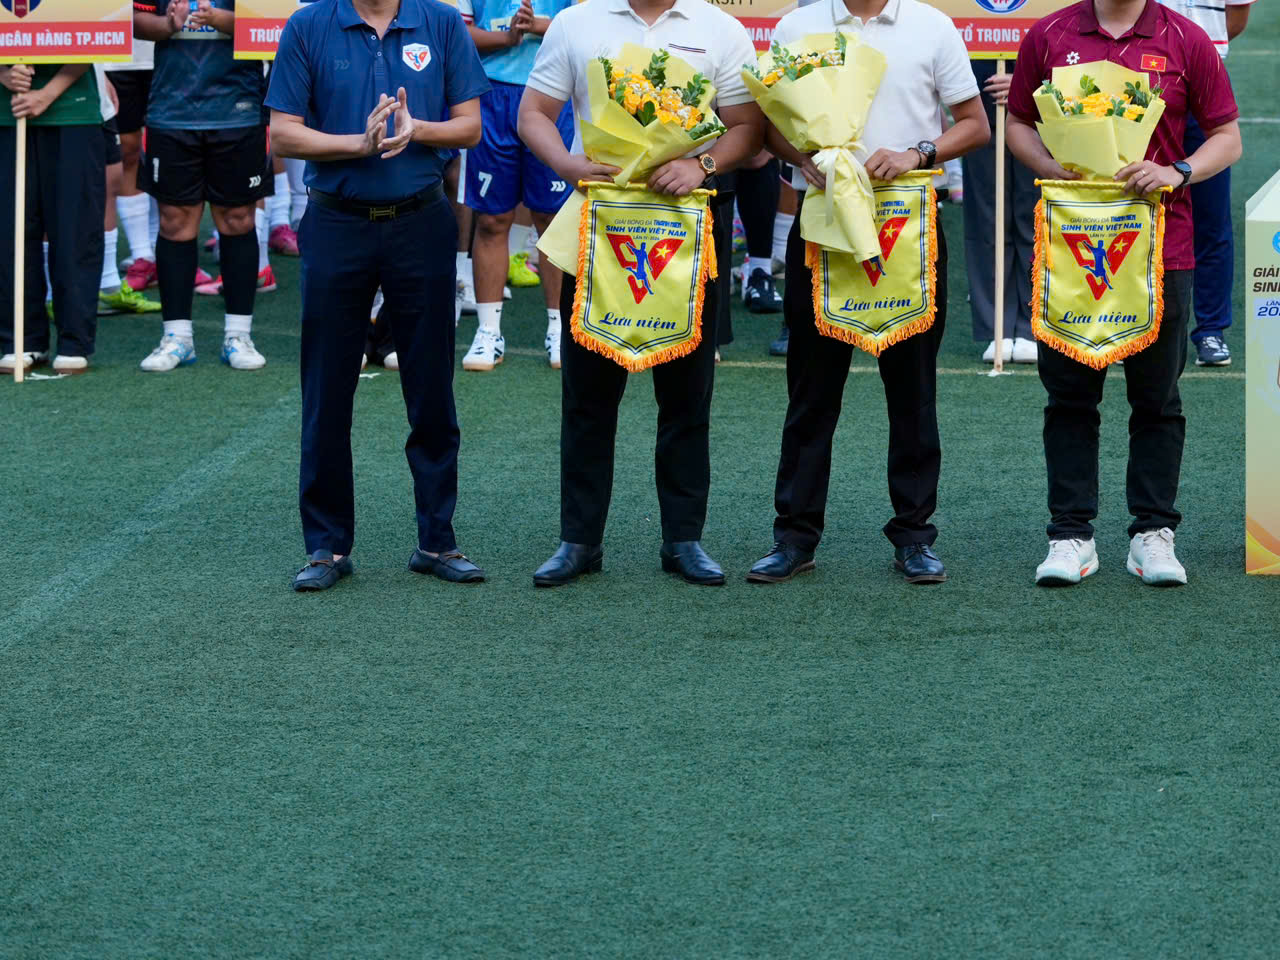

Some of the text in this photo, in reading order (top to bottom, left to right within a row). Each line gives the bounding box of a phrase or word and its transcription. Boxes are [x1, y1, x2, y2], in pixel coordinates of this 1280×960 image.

[36, 29, 72, 47] HÀNG
[75, 31, 125, 46] TP.HCM
[976, 28, 1021, 45] TRỌNG
[478, 171, 493, 198] 7
[606, 224, 625, 232] SINH
[649, 227, 667, 235] VIỆT
[668, 229, 687, 237] NAM
[1084, 223, 1104, 231] VIÊN
[1106, 223, 1122, 231] VIỆT
[1253, 265, 1280, 278] GIẢI
[840, 296, 912, 312] Lưu niệm
[600, 311, 677, 332] Lưu niệm
[1058, 311, 1138, 326] Lưu niệm
